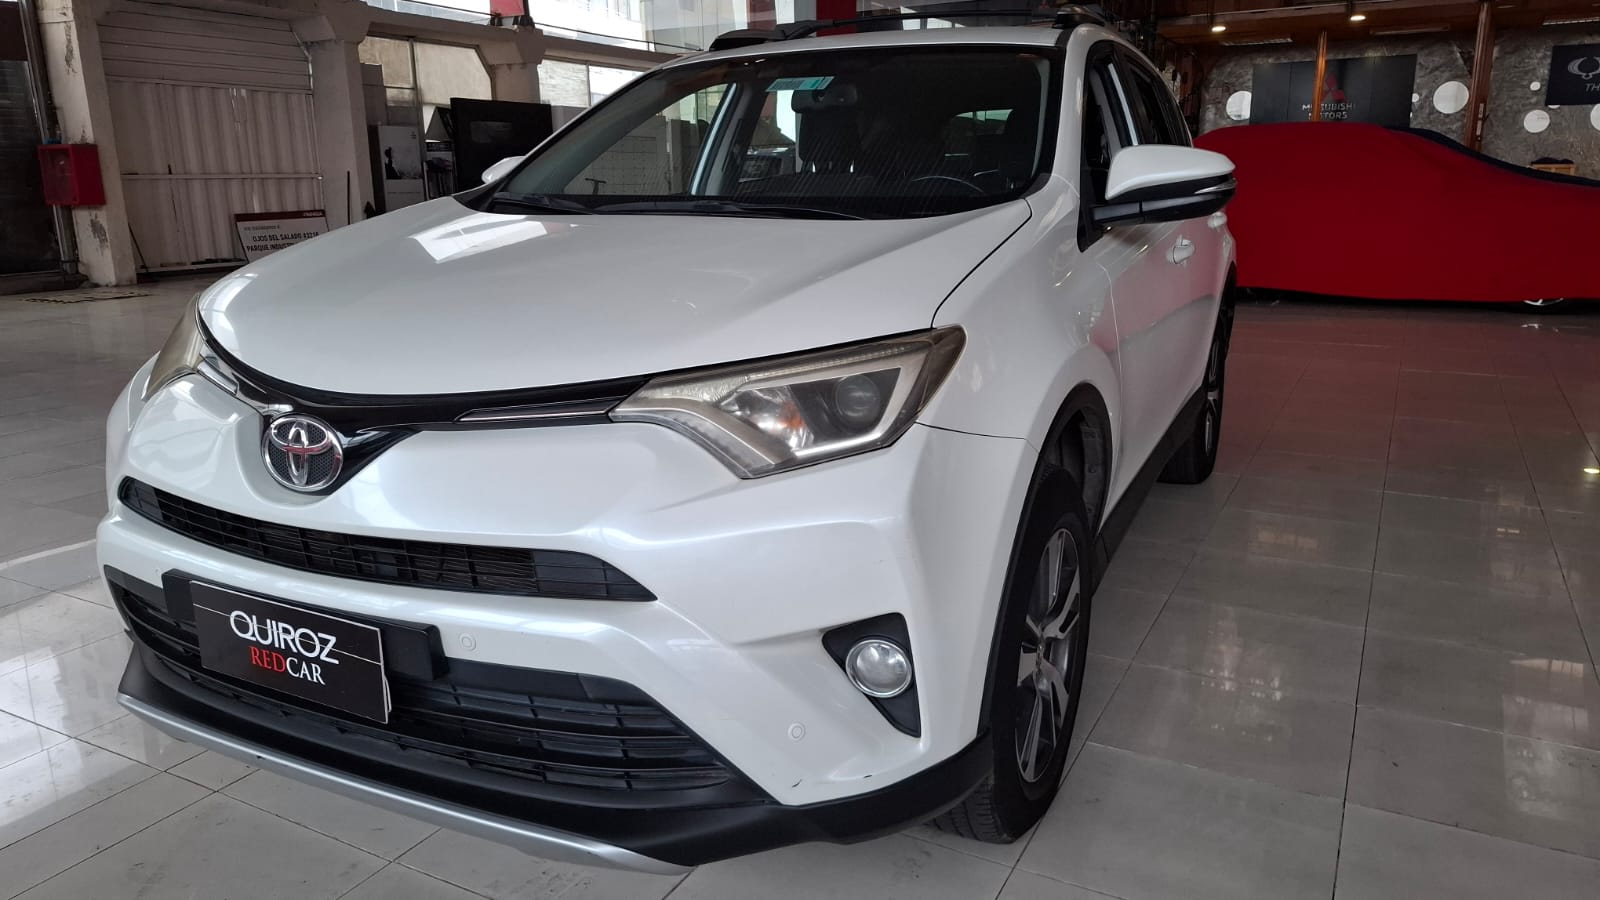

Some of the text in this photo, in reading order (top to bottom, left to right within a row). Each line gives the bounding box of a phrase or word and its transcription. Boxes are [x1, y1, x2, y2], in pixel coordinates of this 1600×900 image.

[1302, 103, 1356, 111] MISUBISHI
[246, 244, 270, 252] PARQUE
[229, 610, 340, 664] QUIROZ
[250, 646, 326, 685] REDCAR
